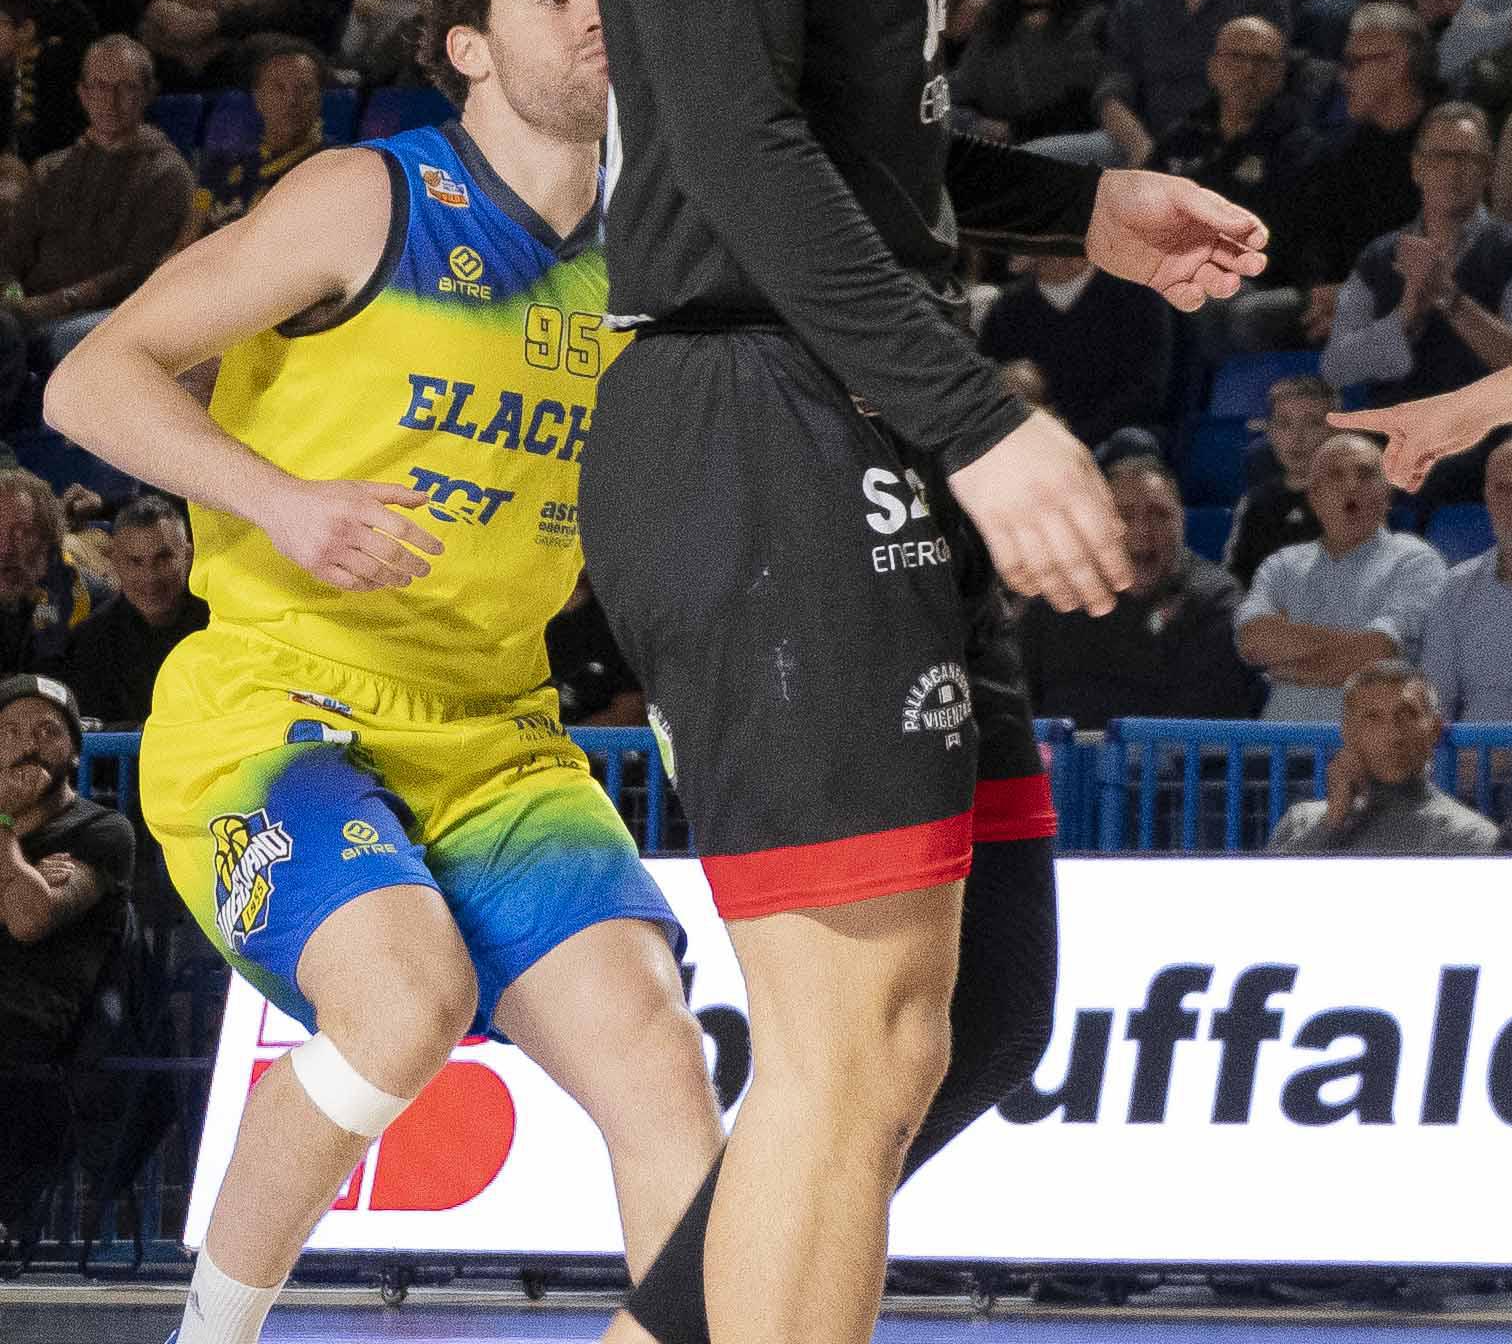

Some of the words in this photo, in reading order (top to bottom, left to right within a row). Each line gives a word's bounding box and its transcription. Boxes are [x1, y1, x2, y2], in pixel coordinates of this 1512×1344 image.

[438, 277, 492, 300] BITRE
[525, 304, 603, 379] 95
[340, 843, 398, 861] BITRE
